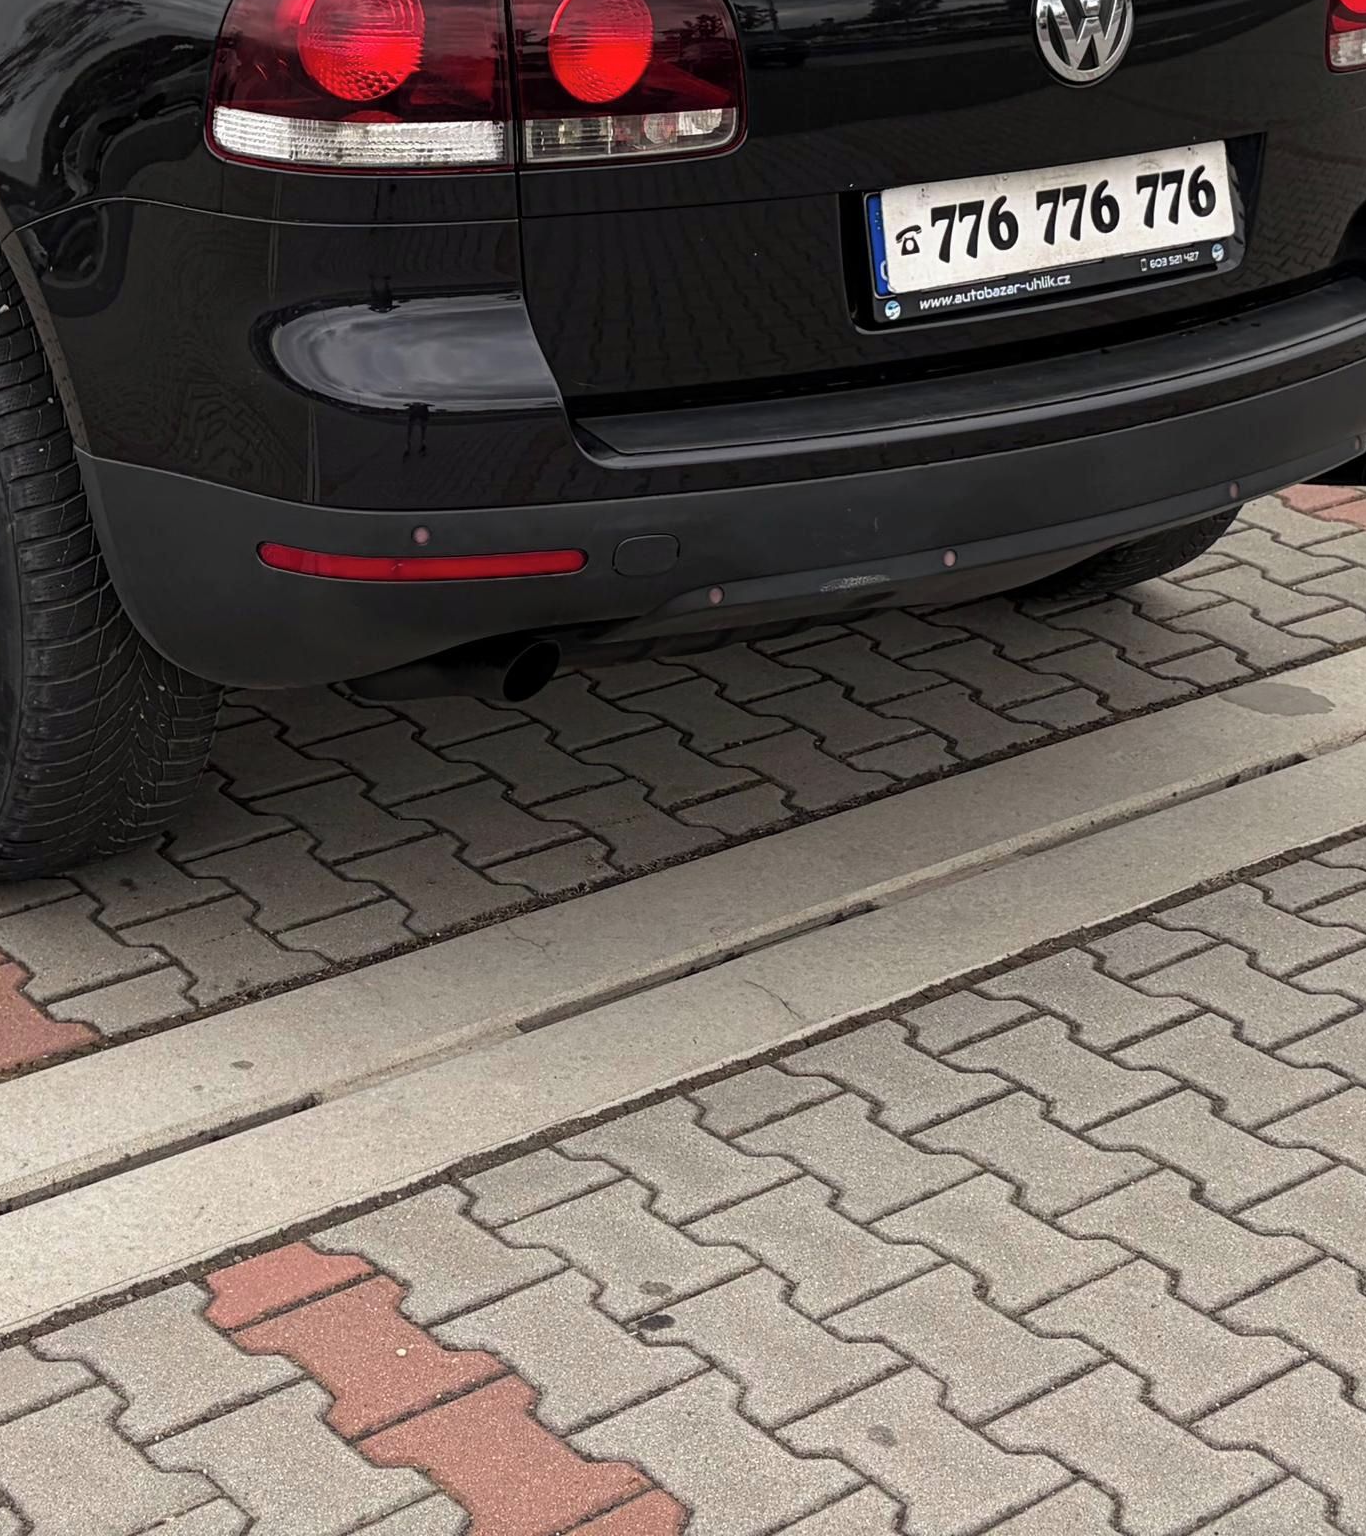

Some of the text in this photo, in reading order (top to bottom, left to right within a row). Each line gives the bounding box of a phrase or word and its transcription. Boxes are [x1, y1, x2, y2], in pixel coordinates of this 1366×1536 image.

[931, 164, 1217, 264] 776 776 776
[919, 274, 1071, 310] www.autobazar-uhlik.cz
